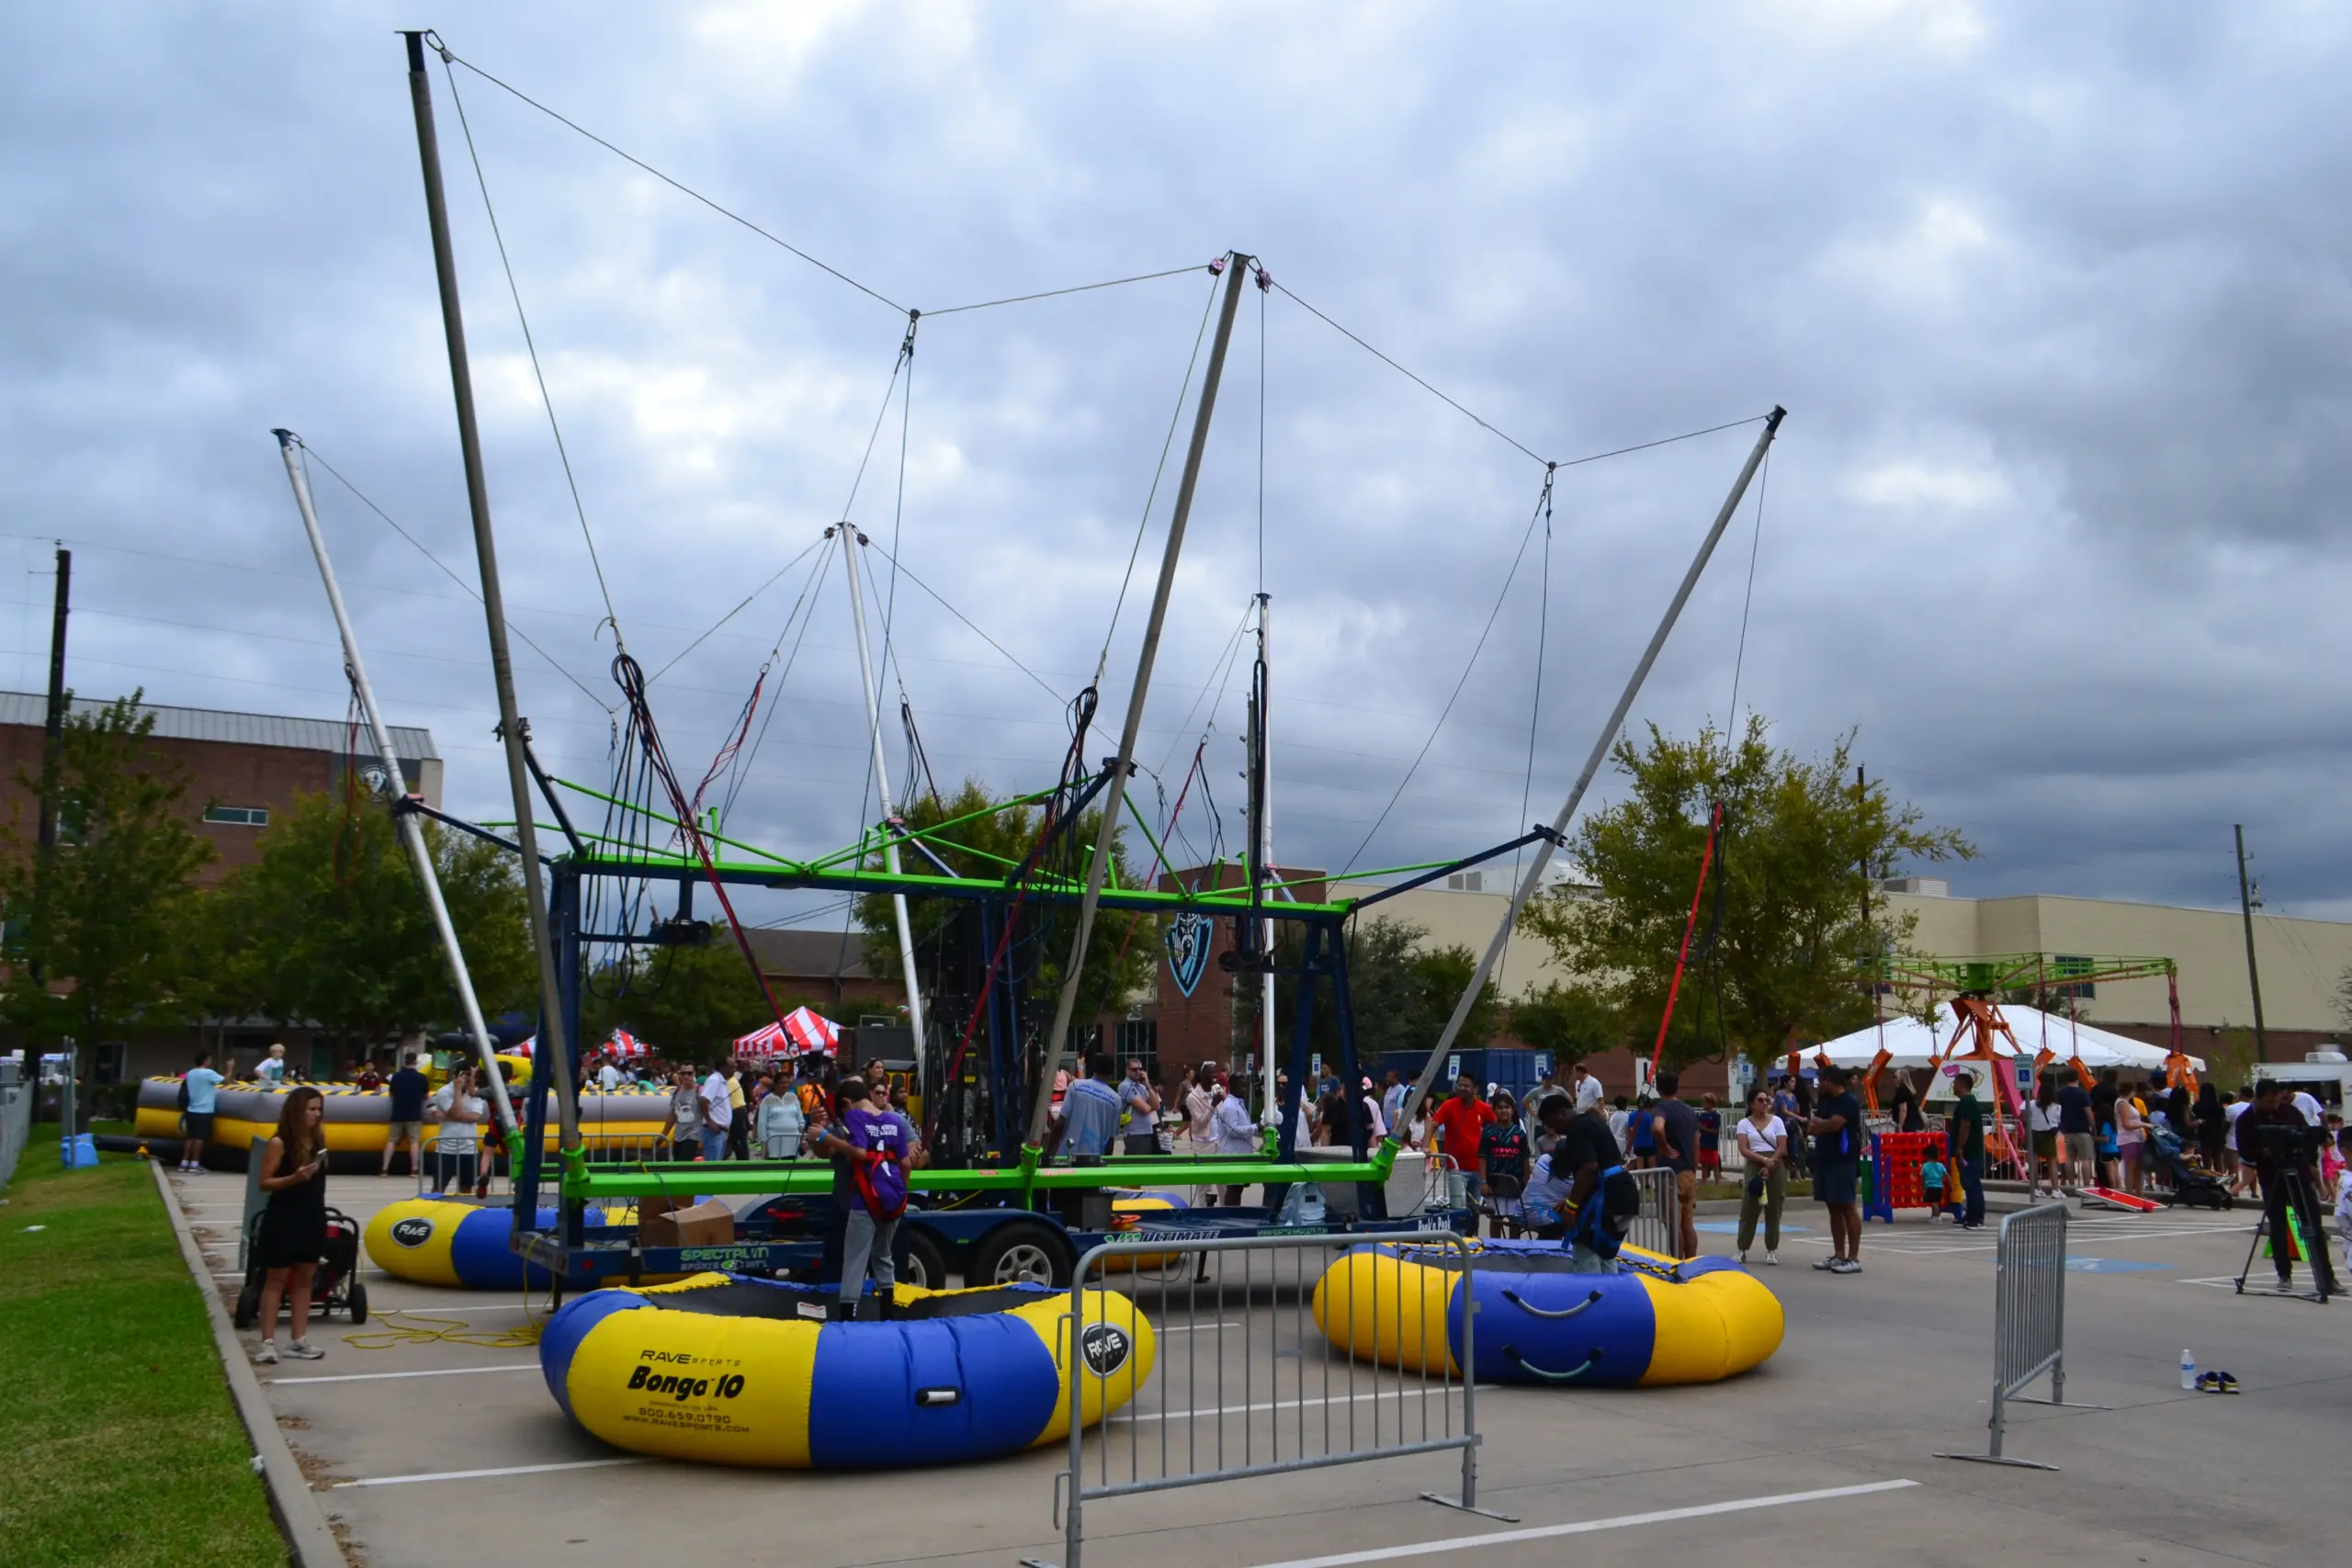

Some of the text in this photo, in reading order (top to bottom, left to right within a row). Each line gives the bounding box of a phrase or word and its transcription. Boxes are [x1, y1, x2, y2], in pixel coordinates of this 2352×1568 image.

[399, 1224, 428, 1235] RAVE
[1142, 1230, 1220, 1242] ULTIMATE
[680, 1247, 769, 1261] SPECTRUM
[680, 1261, 719, 1271] SPORTS
[1087, 1333, 1122, 1359] RAVE
[640, 1350, 741, 1367] RAVE SPORTS
[628, 1366, 745, 1401] Bongo 10
[623, 1415, 751, 1433] WWW.RAVESPORTS.COM
[639, 1407, 731, 1424] 800.659.0790
